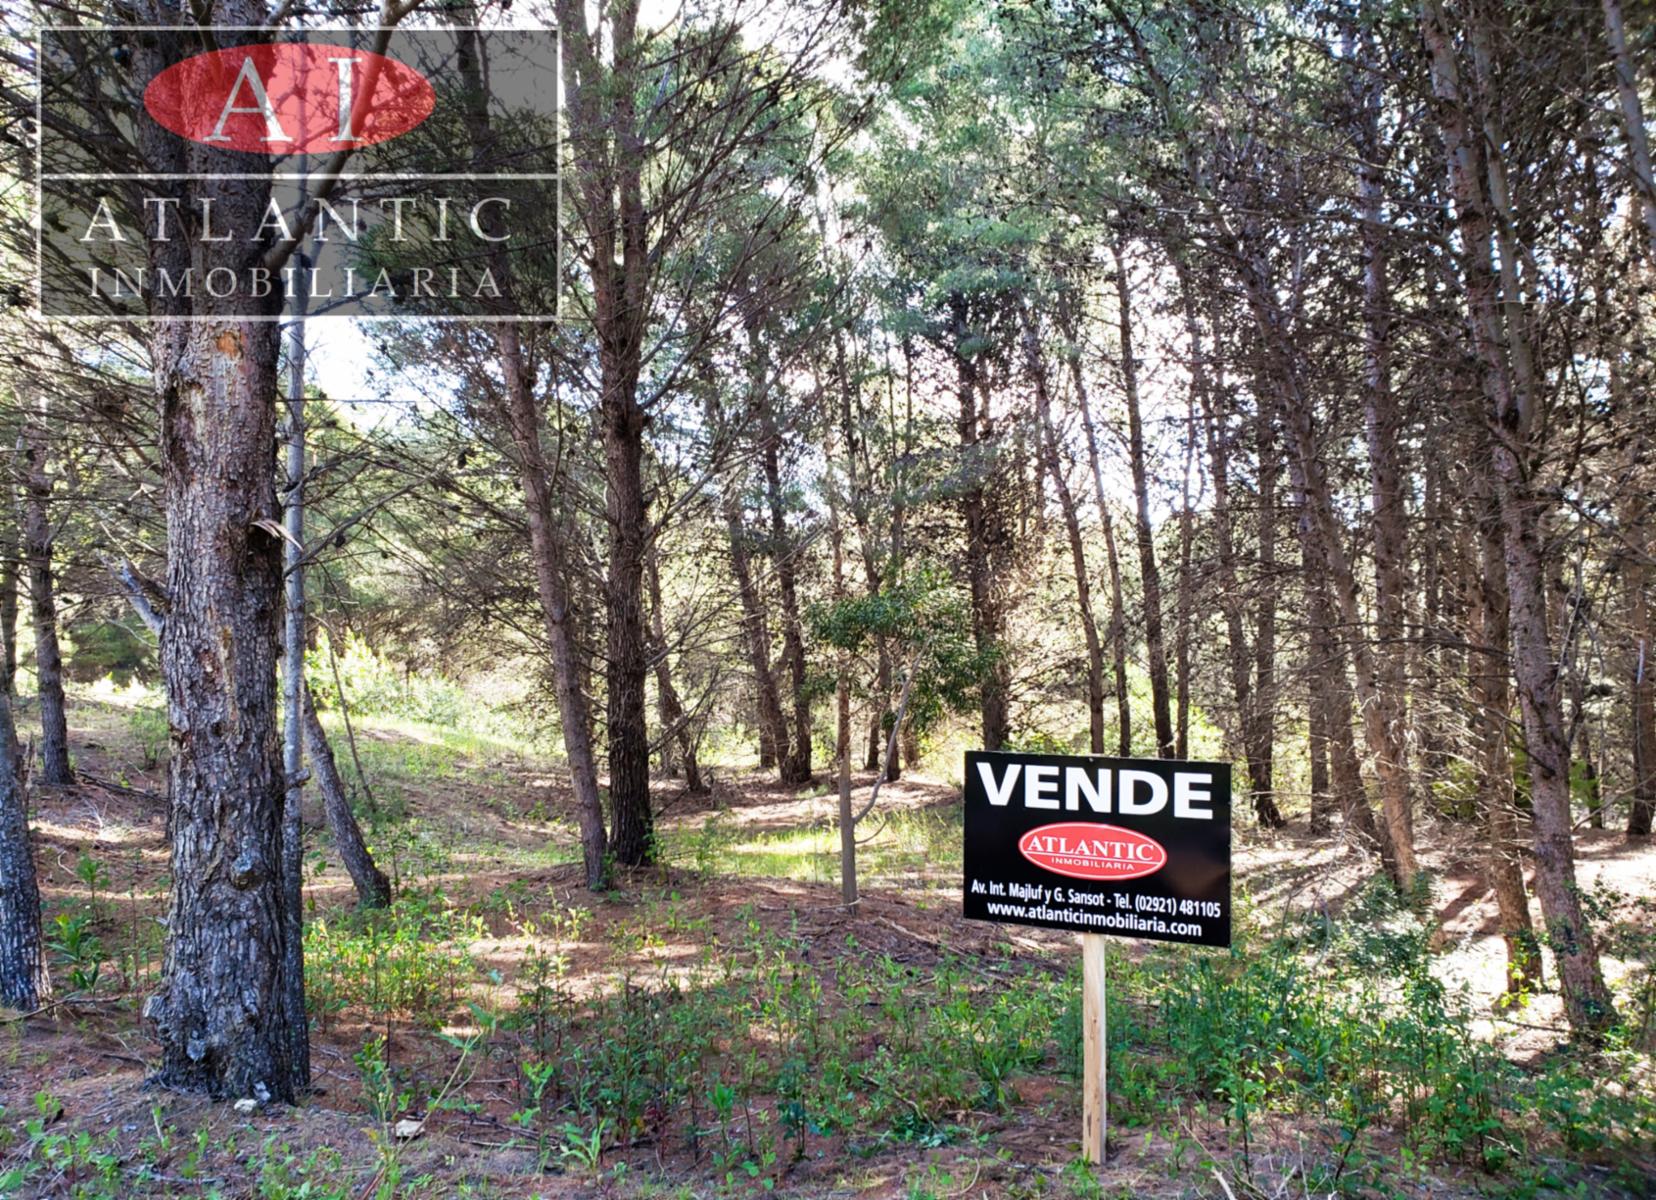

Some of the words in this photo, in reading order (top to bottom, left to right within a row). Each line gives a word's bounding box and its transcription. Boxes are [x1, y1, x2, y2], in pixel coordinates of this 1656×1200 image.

[976, 762, 1213, 819] VENDE
[1027, 835, 1154, 861] ATLANTIC
[1051, 857, 1135, 871] INMOBILIARIA
[971, 879, 987, 895] Av.
[989, 881, 1006, 896] Int.
[1009, 883, 1043, 902] Majluf
[1045, 889, 1052, 904] y
[1054, 888, 1065, 902] G.
[1068, 889, 1105, 906] Sansot
[1114, 893, 1132, 909] Tel.
[1135, 894, 1177, 915] (02921)
[1179, 899, 1221, 918] 481105
[987, 901, 1202, 936] www.atlanticinmobiliaria.com
